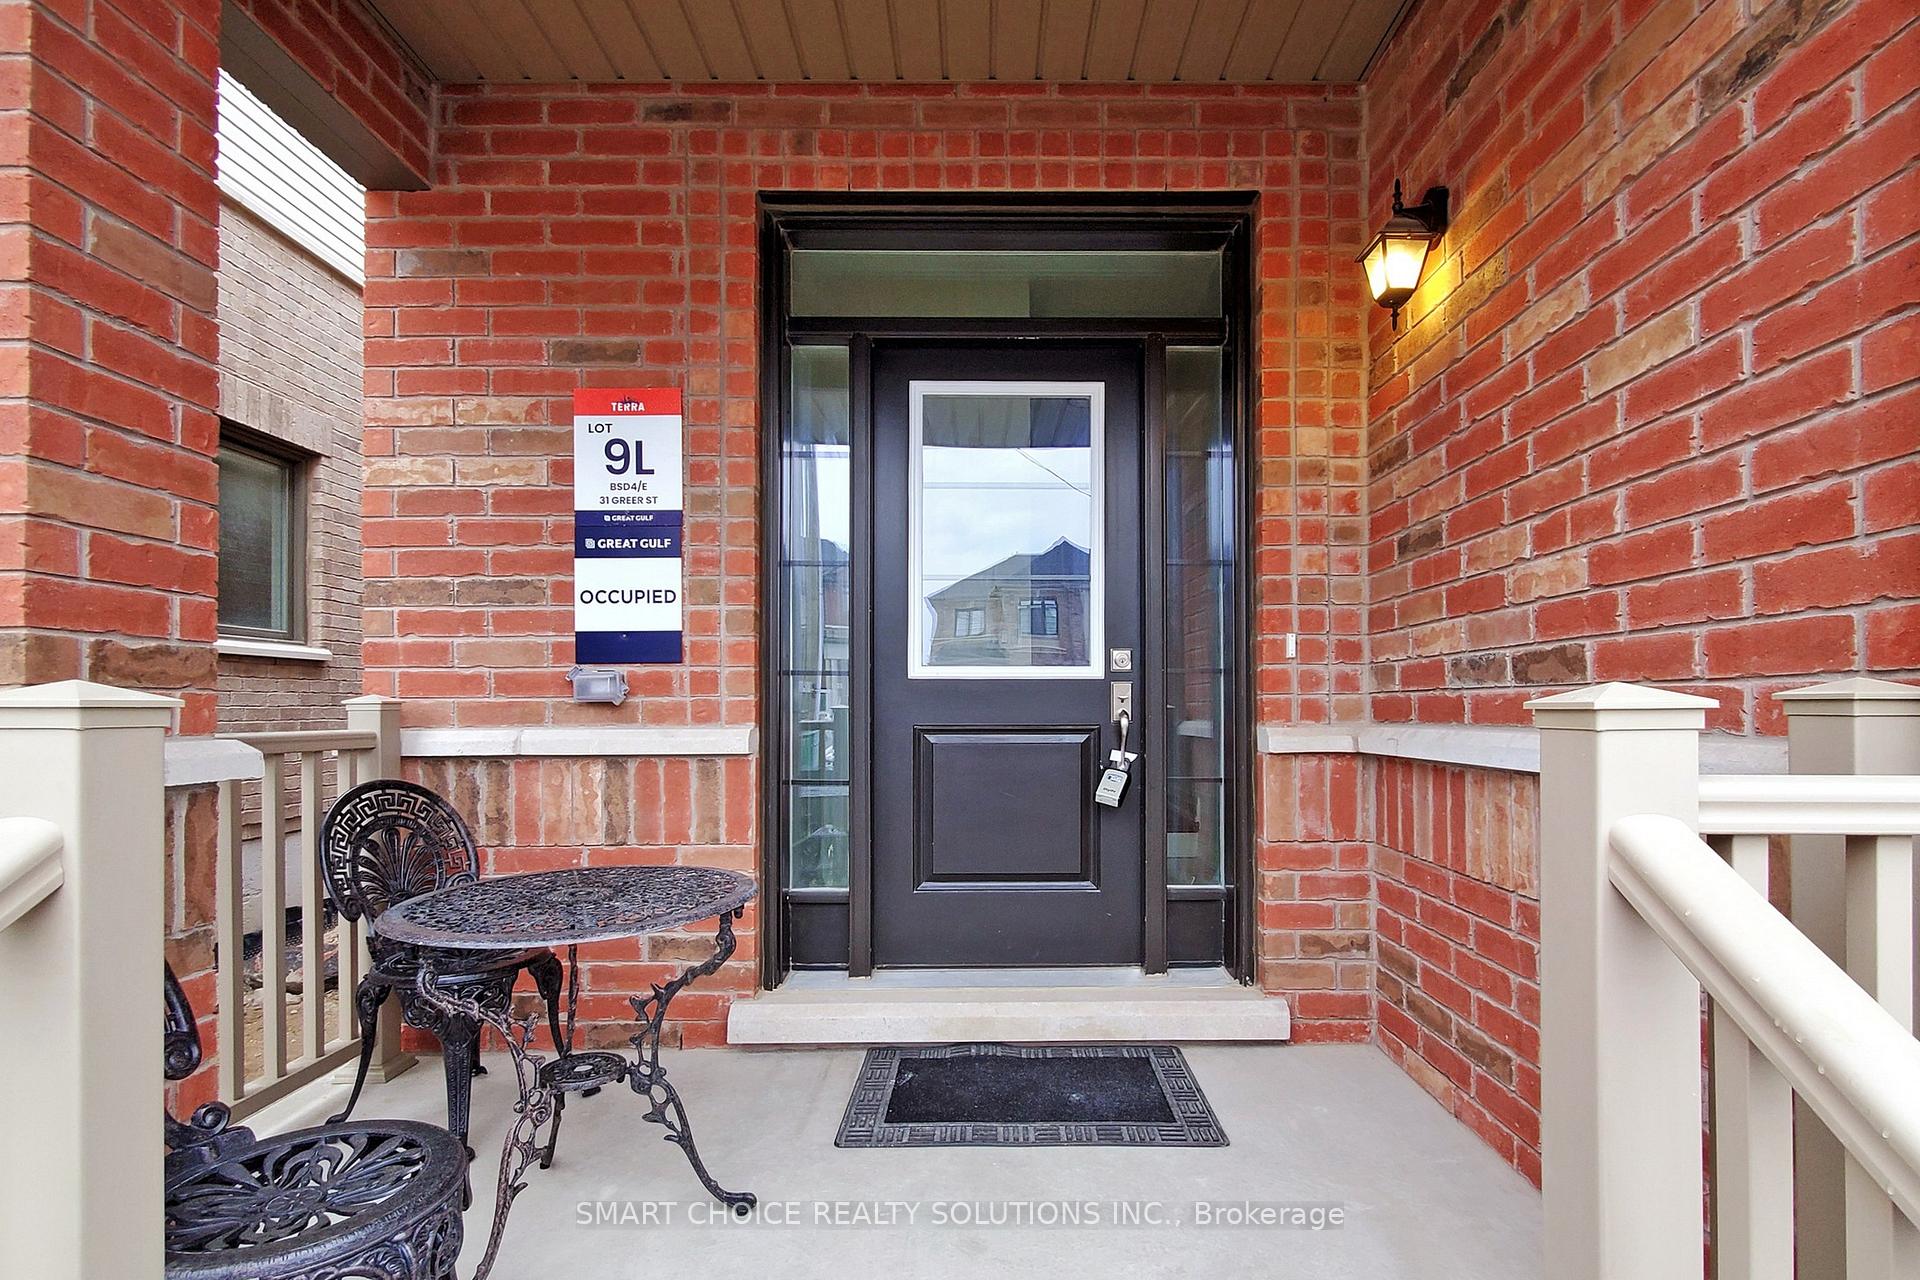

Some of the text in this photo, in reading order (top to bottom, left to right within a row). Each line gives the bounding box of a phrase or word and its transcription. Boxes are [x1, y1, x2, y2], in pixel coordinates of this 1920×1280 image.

[611, 402, 645, 411] TERRA
[588, 424, 613, 433] LOT
[604, 438, 655, 475] 9L
[610, 481, 648, 492] BSD4/E
[599, 496, 658, 504] 31 GREER ST
[611, 514, 654, 522] GREAT GULF
[597, 538, 672, 549] GREAT GULF
[580, 589, 677, 604] OCCUPIED
